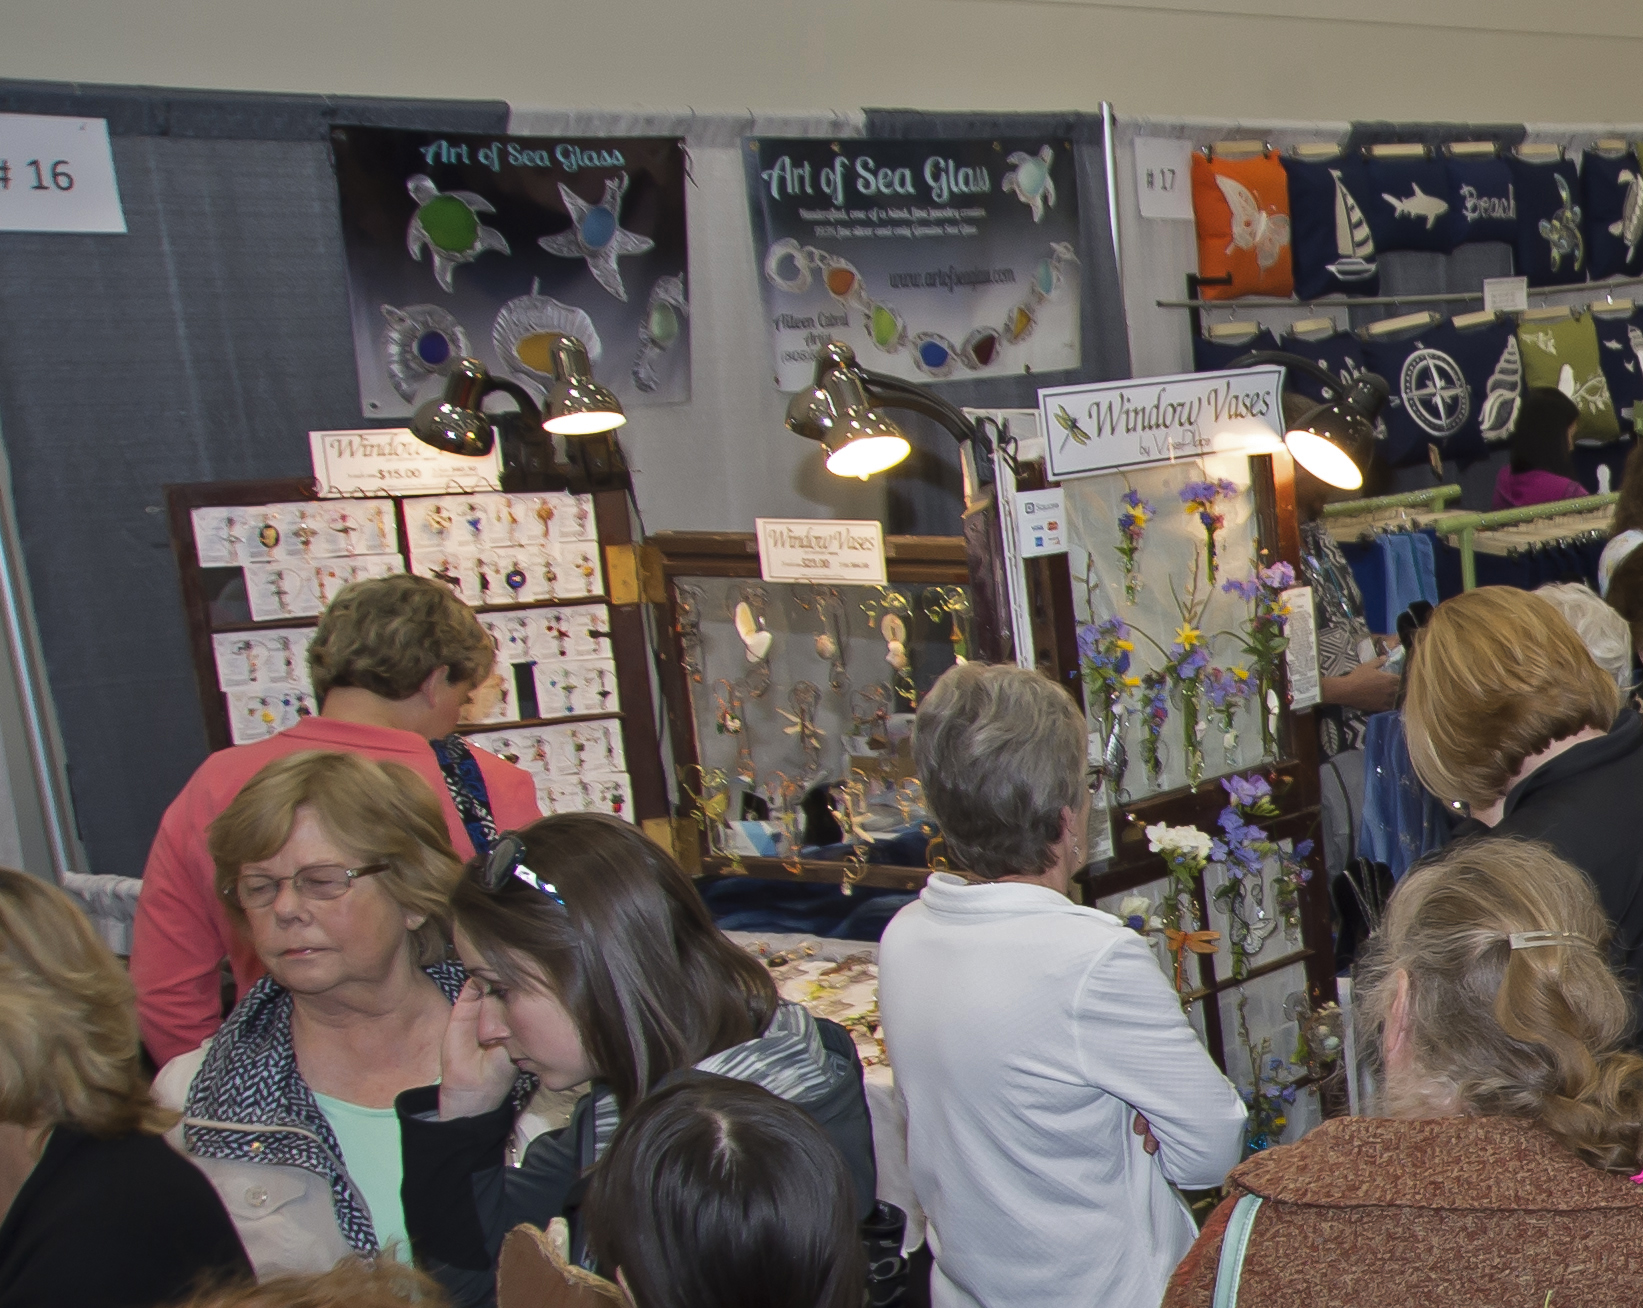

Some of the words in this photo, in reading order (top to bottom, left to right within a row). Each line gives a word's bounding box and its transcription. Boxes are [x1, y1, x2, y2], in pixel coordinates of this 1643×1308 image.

[419, 140, 471, 165] Art
[478, 142, 503, 173] of
[507, 142, 552, 167] Sea
[555, 143, 626, 173] Glass
[27, 159, 75, 191] 16
[761, 155, 815, 201] Art
[820, 155, 850, 207] of
[854, 156, 916, 196] Sea
[924, 155, 992, 204] Glass
[1160, 167, 1176, 191] 17
[1088, 386, 1202, 438] Window
[1207, 380, 1271, 424] Vases
[377, 468, 422, 480] $15.00
